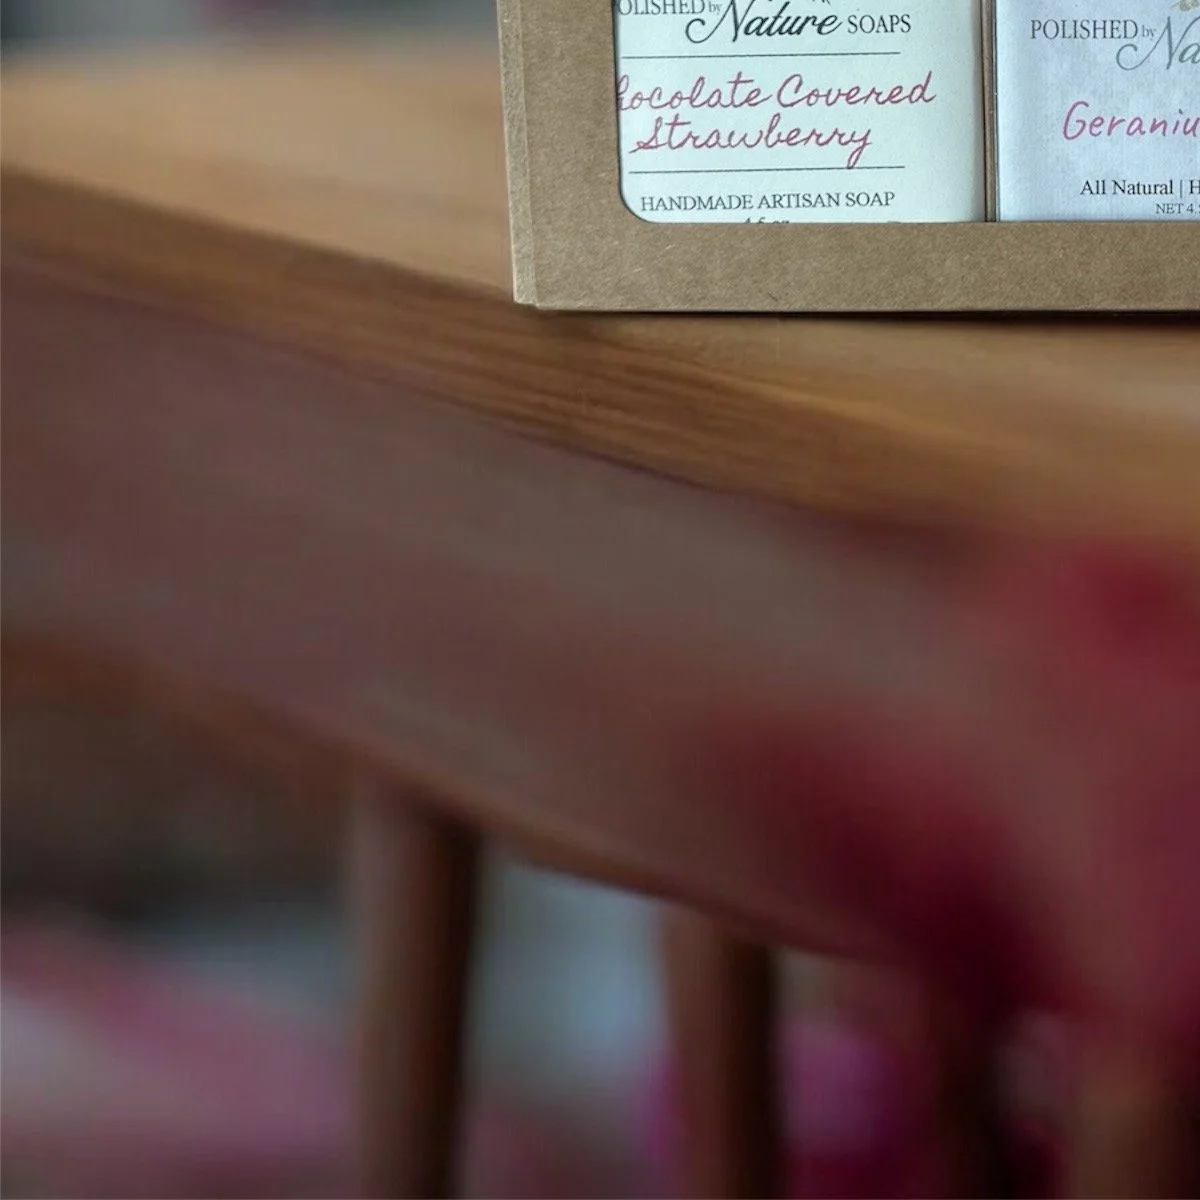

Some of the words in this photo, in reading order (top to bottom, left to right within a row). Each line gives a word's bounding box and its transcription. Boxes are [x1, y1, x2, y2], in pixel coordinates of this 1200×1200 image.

[707, 0, 723, 16] by
[847, 13, 912, 35] SOAPS
[1030, 19, 1138, 41] POLISHED
[1141, 25, 1157, 40] by
[776, 70, 937, 109] Covered
[628, 112, 873, 169] Strawberry
[1079, 179, 1106, 196] All
[1111, 179, 1174, 196] Natural
[640, 194, 754, 212] HANDMADE
[757, 192, 842, 209] ARTISAN
[844, 190, 896, 207] SOAP
[1155, 203, 1184, 214] NET
